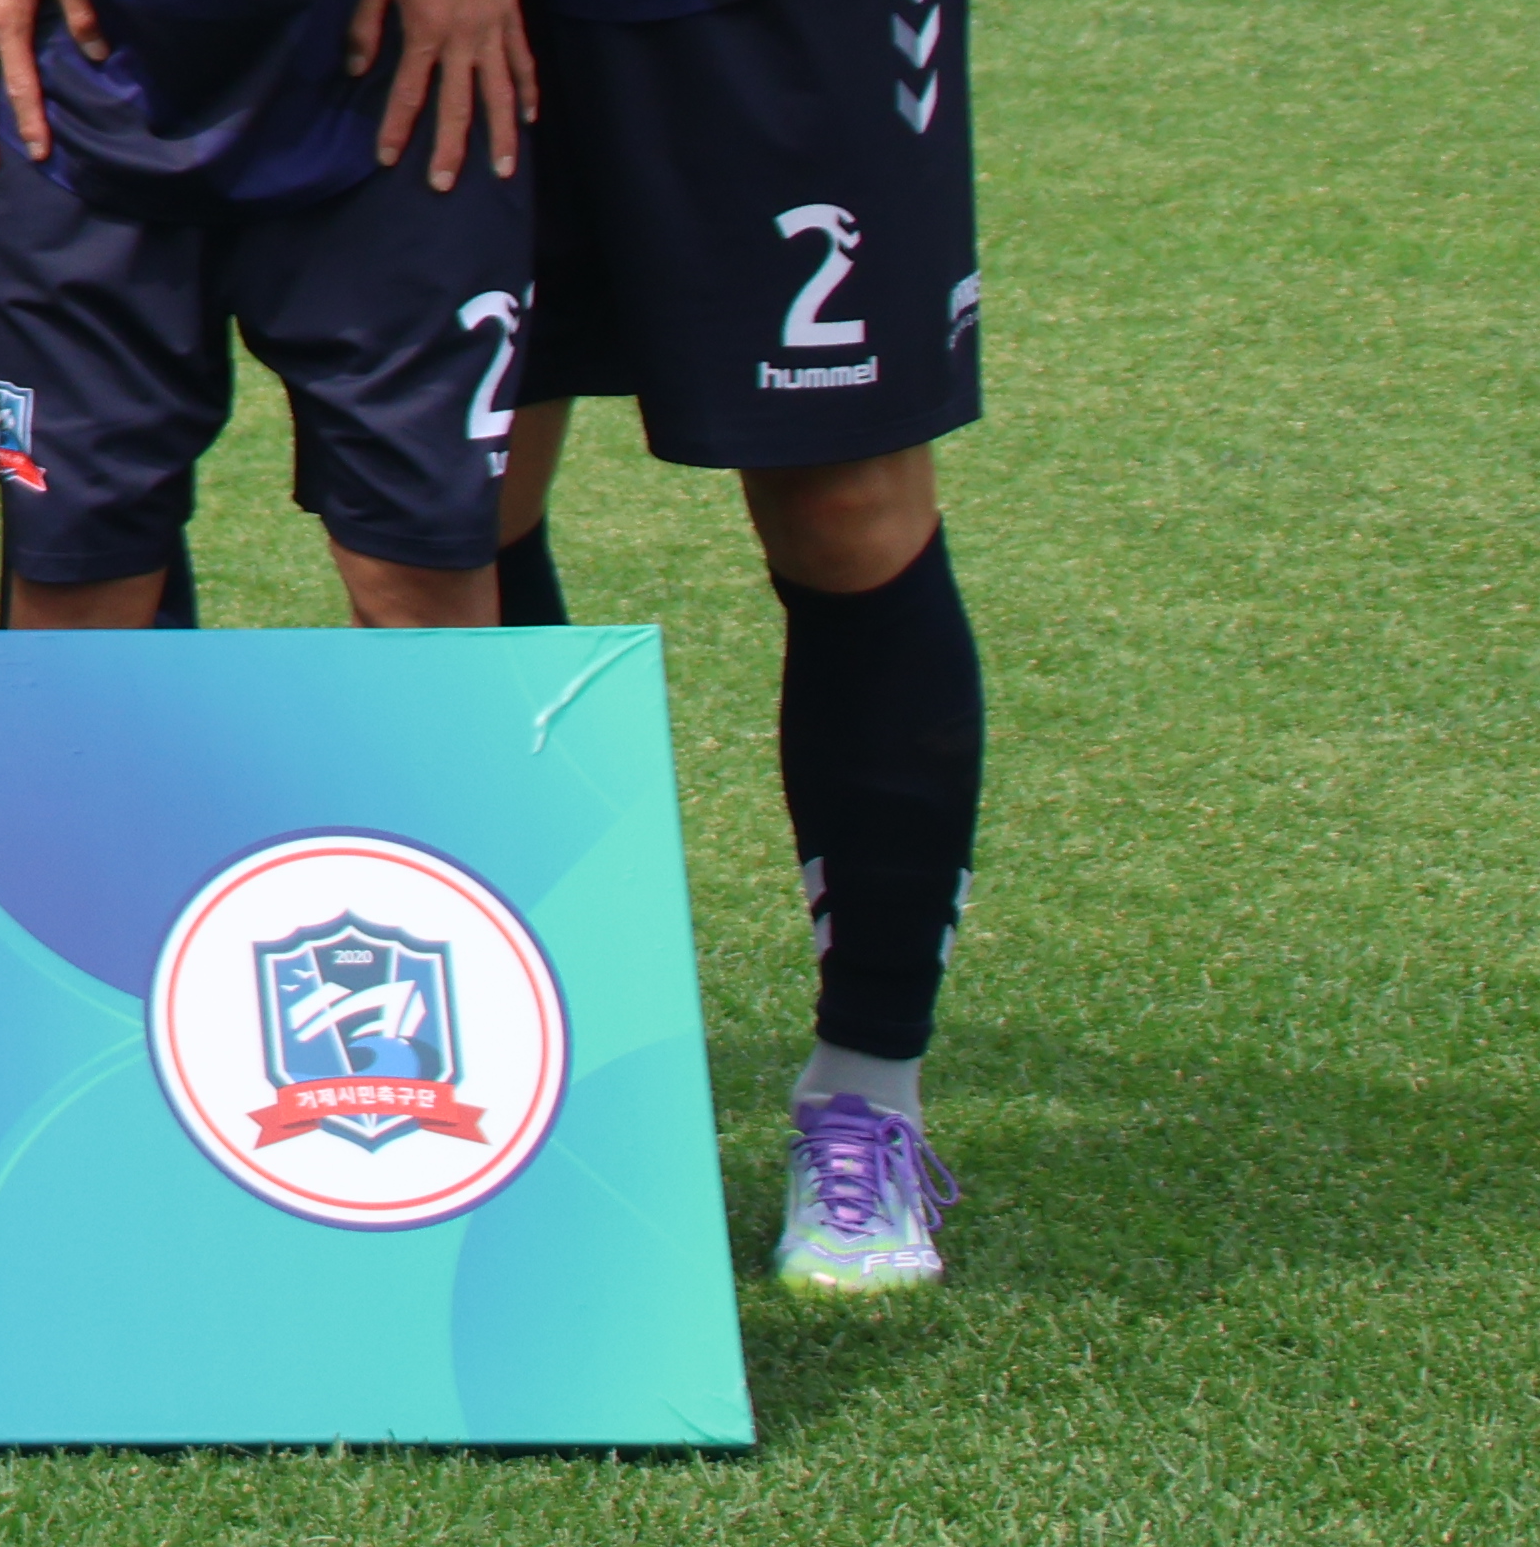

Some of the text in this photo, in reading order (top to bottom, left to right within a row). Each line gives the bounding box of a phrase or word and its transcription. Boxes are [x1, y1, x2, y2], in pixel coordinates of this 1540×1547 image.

[774, 203, 864, 348] 2
[756, 355, 878, 390] hummel
[332, 948, 375, 965] 2020
[295, 1083, 438, 1110] 거제시민축구단
